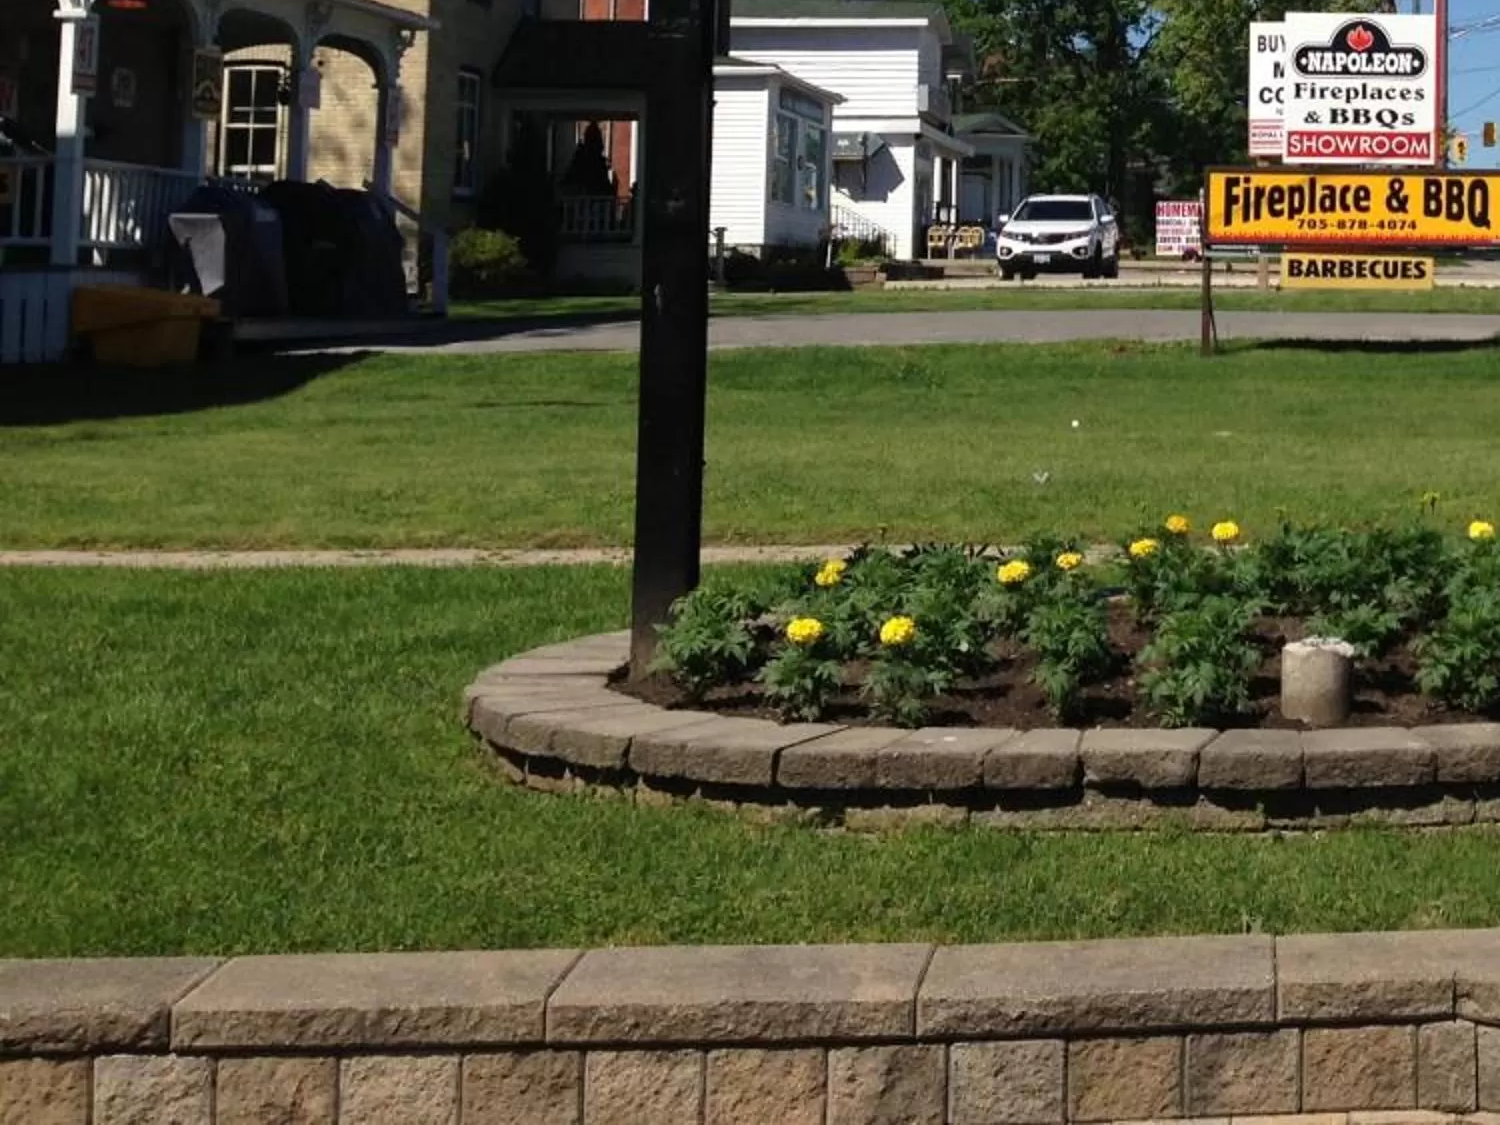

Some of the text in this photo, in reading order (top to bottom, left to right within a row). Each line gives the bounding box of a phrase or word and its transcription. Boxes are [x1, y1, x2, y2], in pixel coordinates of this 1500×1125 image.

[1307, 51, 1414, 74] NAPOLEON
[1294, 82, 1425, 103] Fireplaces
[1304, 111, 1322, 124] &
[1329, 108, 1416, 129] BBQs
[1289, 134, 1429, 155] SHOWROOM
[1223, 176, 1491, 230] Fireplace & BBQ
[1287, 258, 1427, 280] BARBECUES
